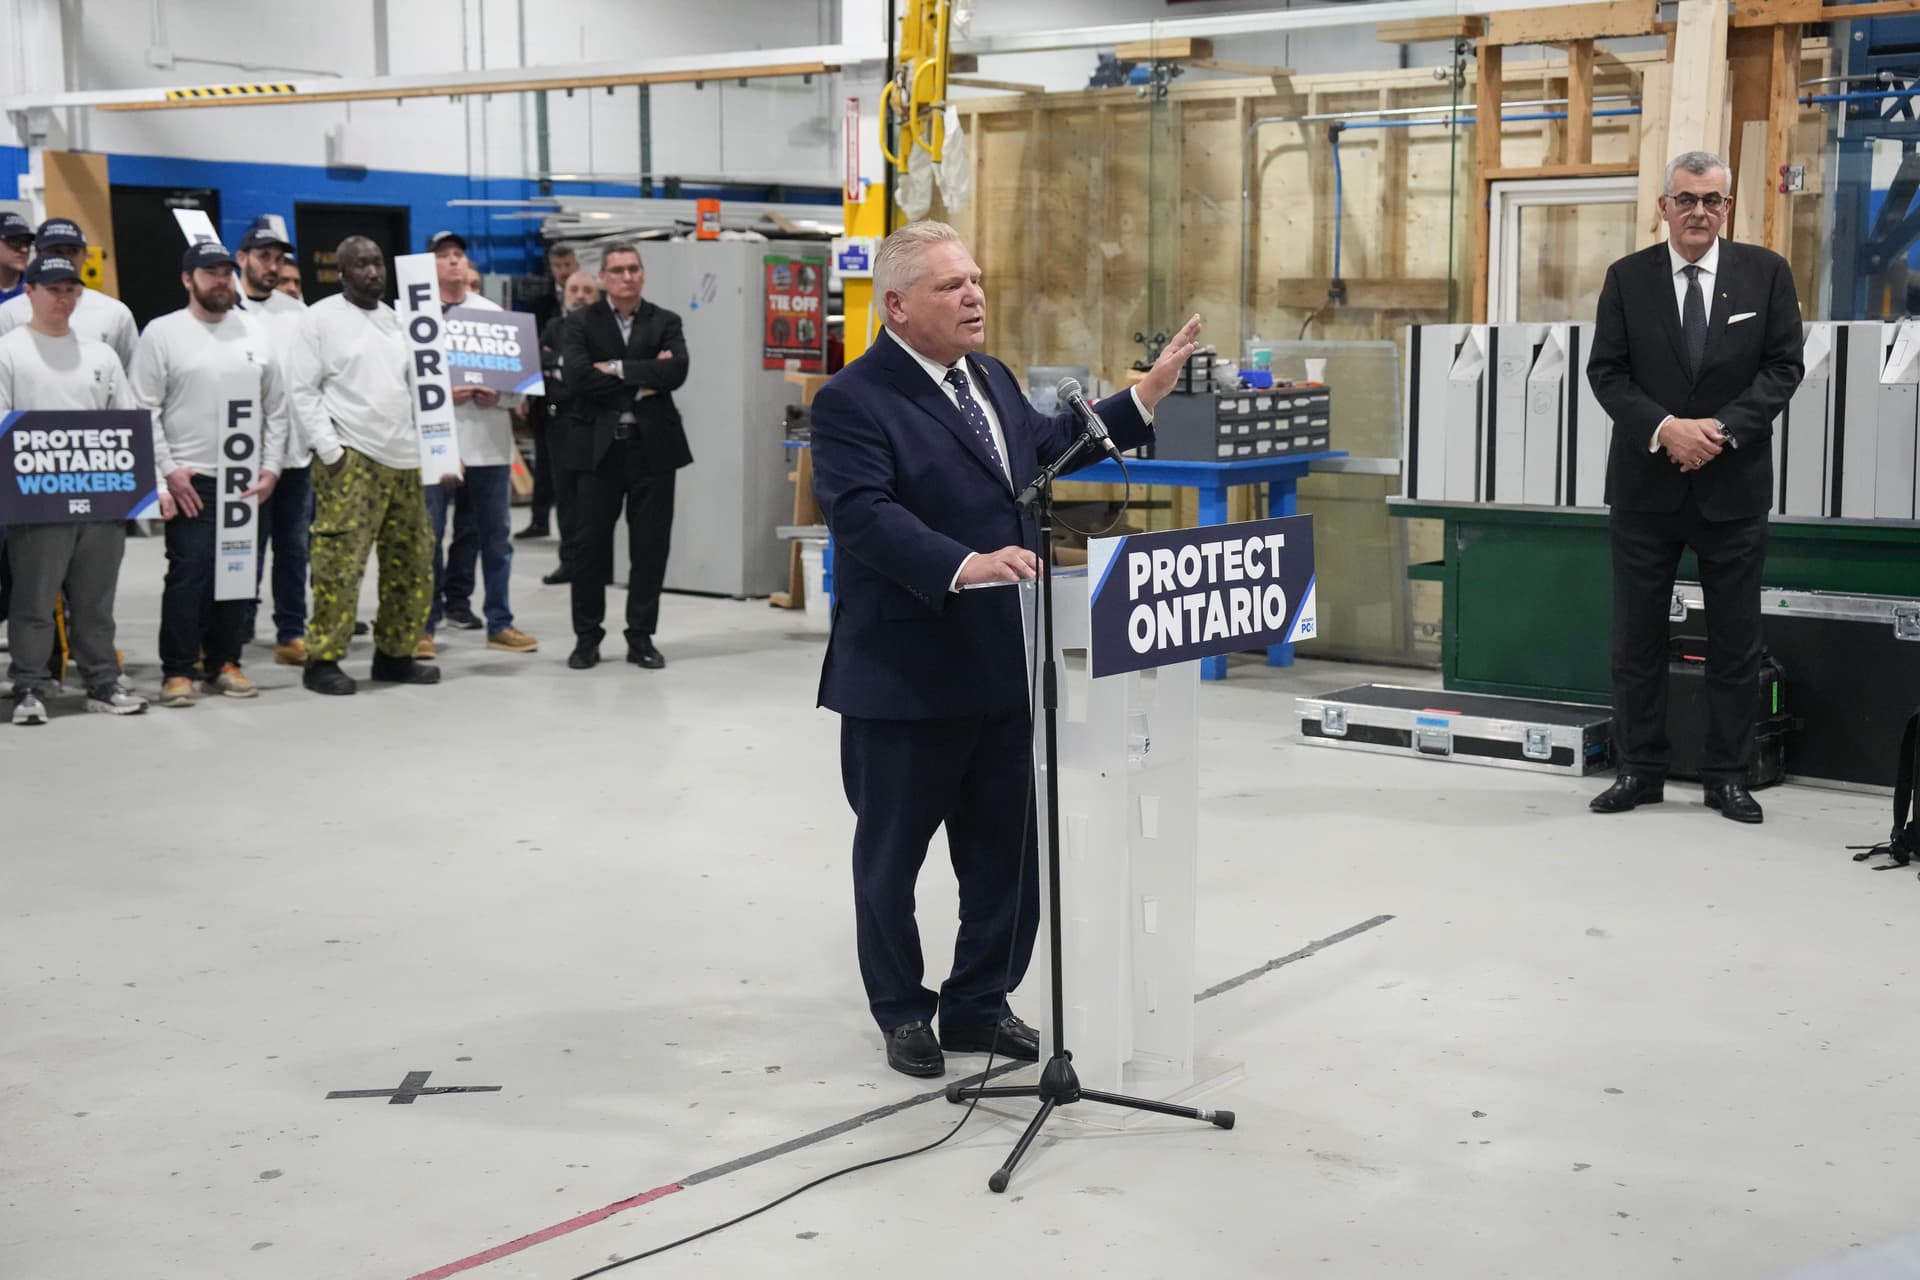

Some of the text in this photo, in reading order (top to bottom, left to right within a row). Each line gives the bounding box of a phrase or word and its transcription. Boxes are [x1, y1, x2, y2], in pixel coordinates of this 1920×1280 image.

[792, 295, 819, 312] OFF
[408, 283, 446, 412] FORD
[13, 429, 133, 452] PROTECT
[14, 449, 135, 473] ONTARIO
[16, 472, 137, 495] WORKERS
[223, 400, 255, 529] FORD
[1128, 533, 1285, 601] PROTECT
[1128, 583, 1287, 654] ONTARIO
